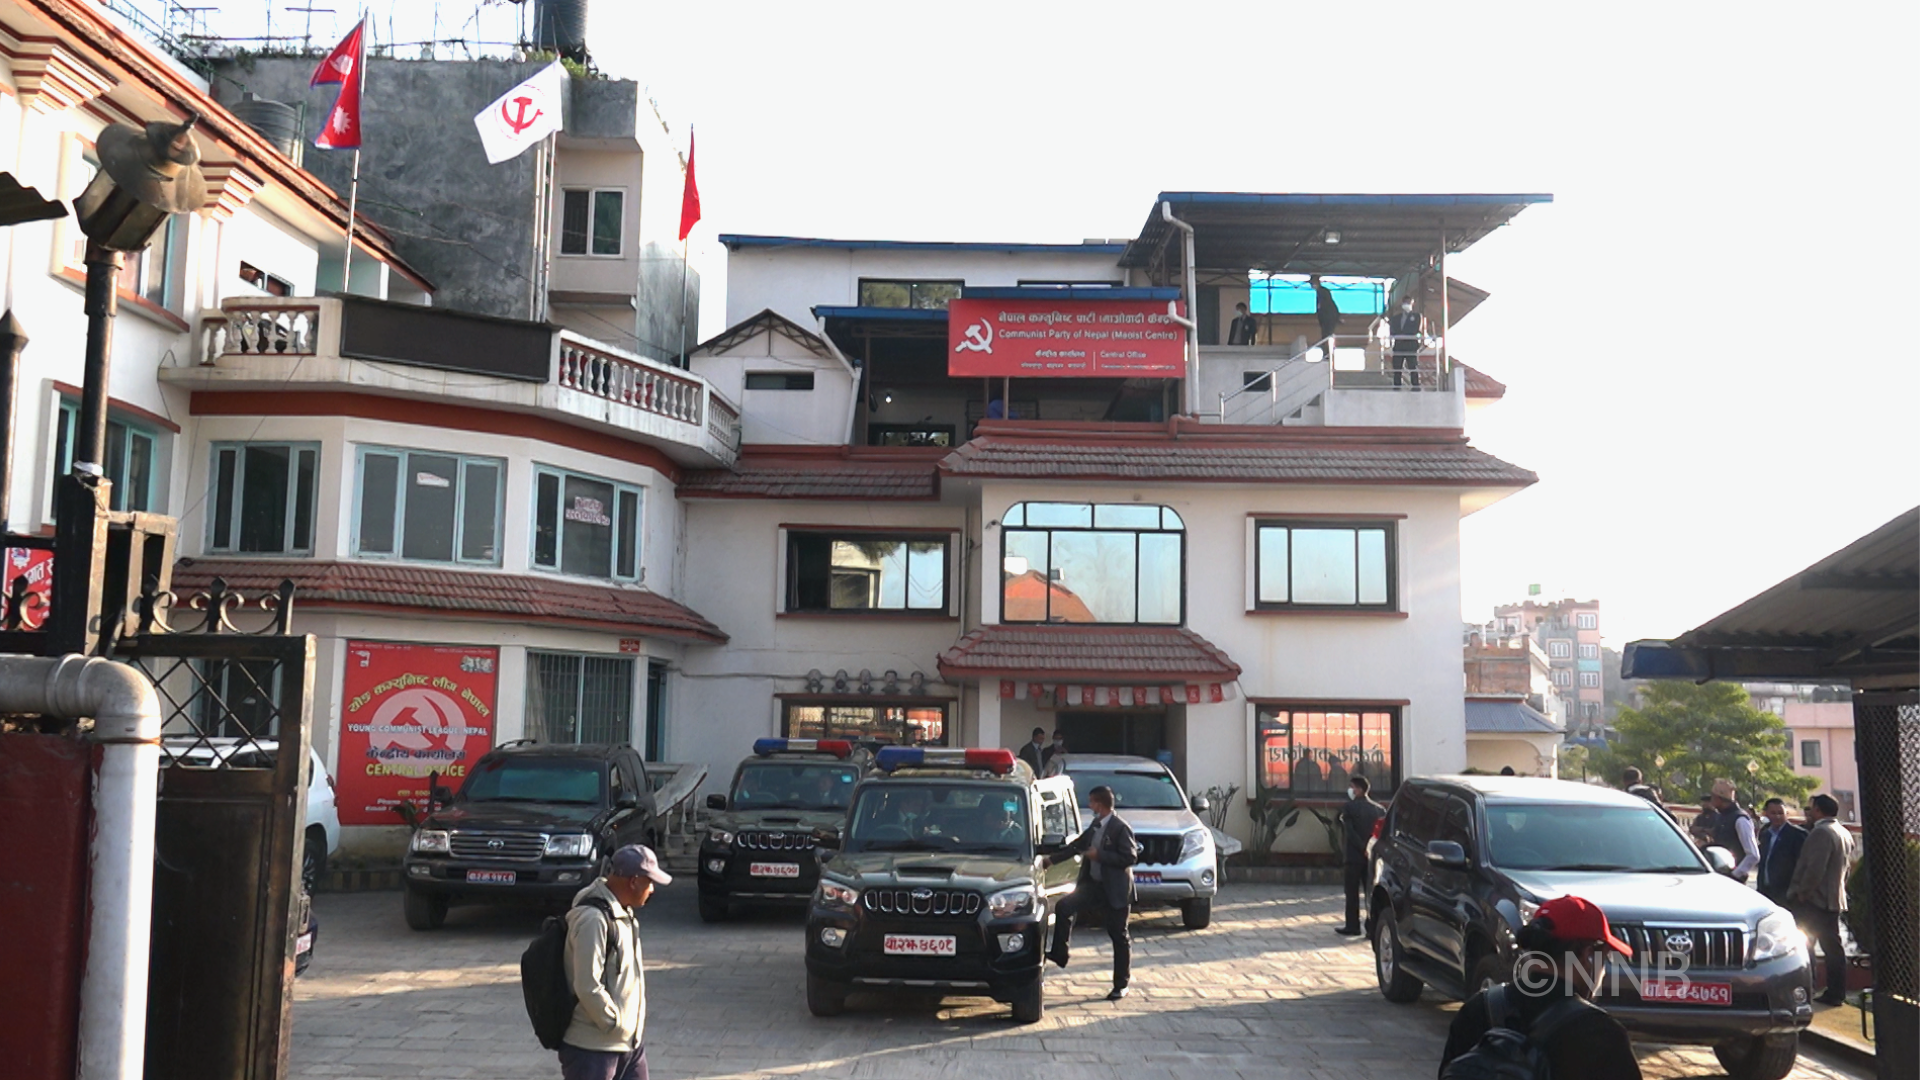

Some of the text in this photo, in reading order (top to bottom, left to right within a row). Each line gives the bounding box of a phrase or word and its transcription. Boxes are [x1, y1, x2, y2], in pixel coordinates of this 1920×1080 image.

[999, 310, 1025, 323] नेपाल
[999, 329, 1178, 341] Communist Party of Nepal (Maoist Centre)
[461, 686, 491, 718] नेपाल
[347, 724, 376, 734] YOUNG
[378, 725, 426, 735] COMMUNIST
[463, 726, 488, 736] NEPAL
[365, 763, 420, 777] CENTRAL
